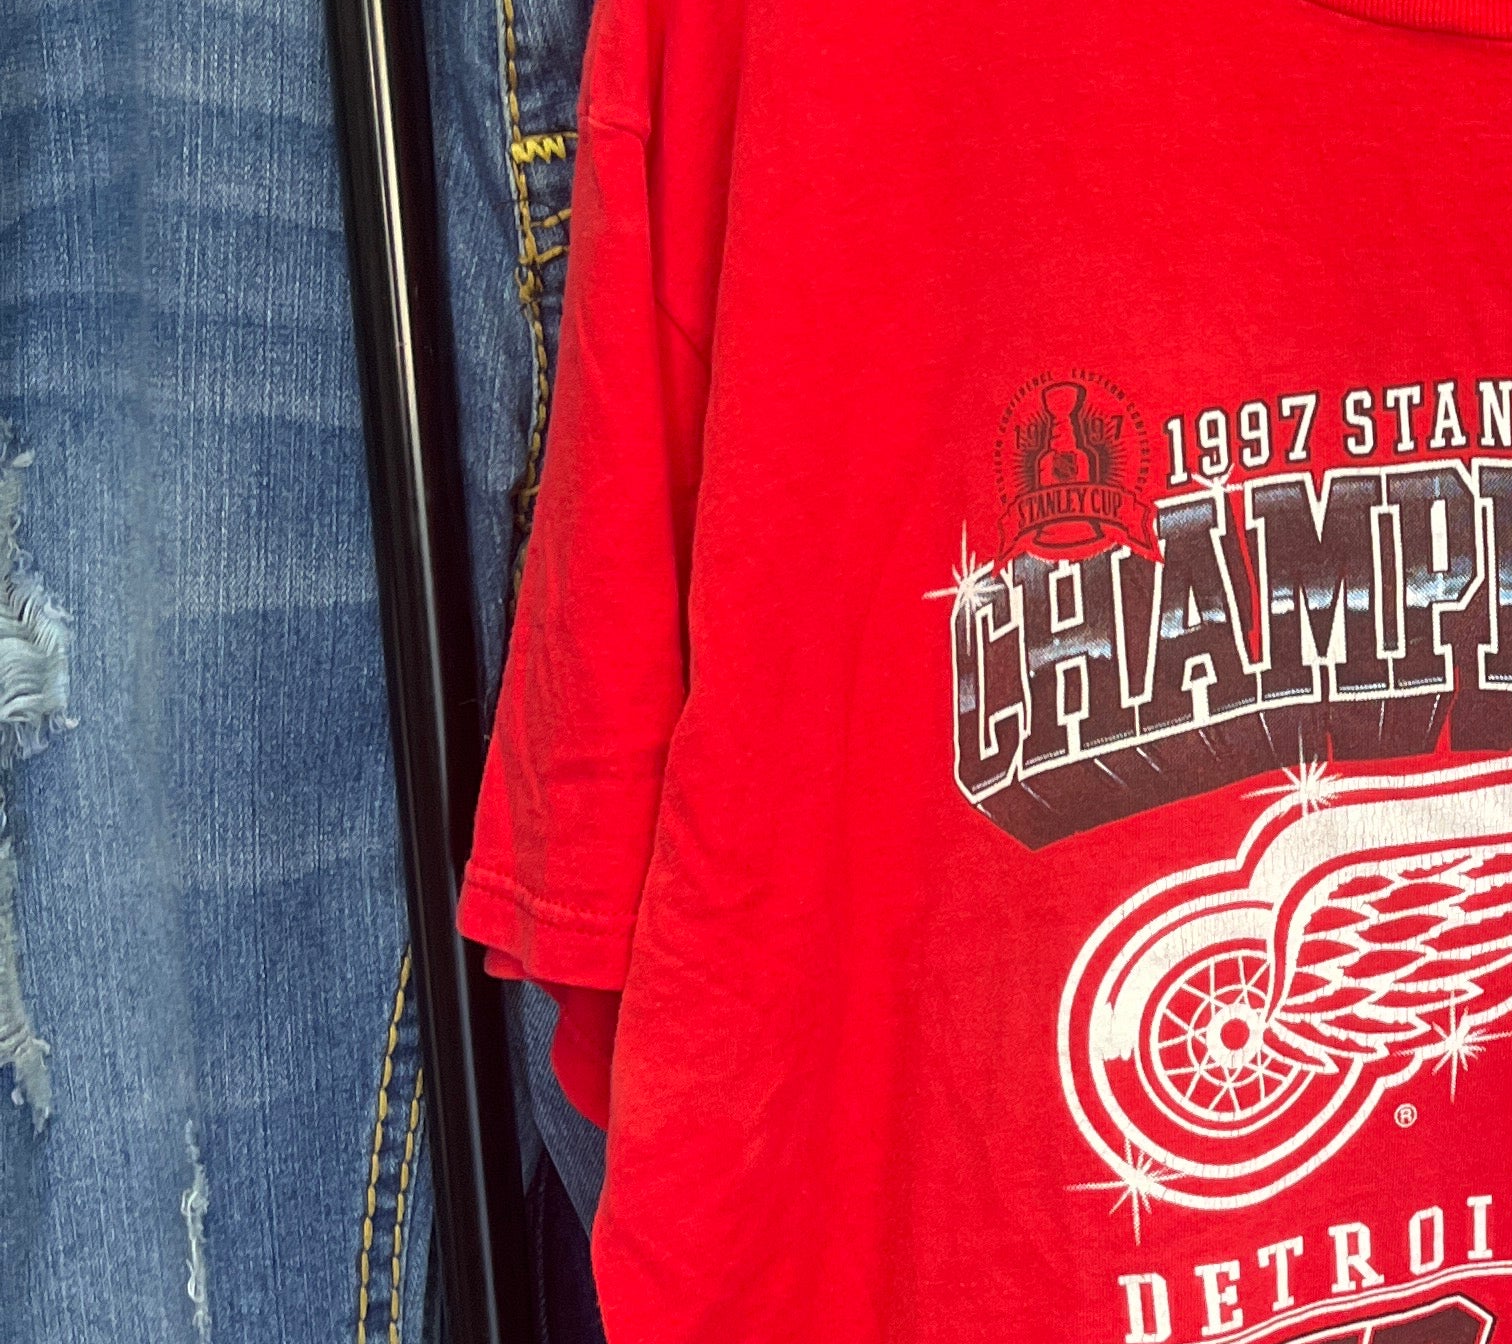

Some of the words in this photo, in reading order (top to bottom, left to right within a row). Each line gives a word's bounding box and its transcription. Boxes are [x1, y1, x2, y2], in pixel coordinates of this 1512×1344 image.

[1163, 391, 1320, 486] 1997
[1018, 487, 1088, 527] STANLEY
[1089, 487, 1124, 521] CUP
